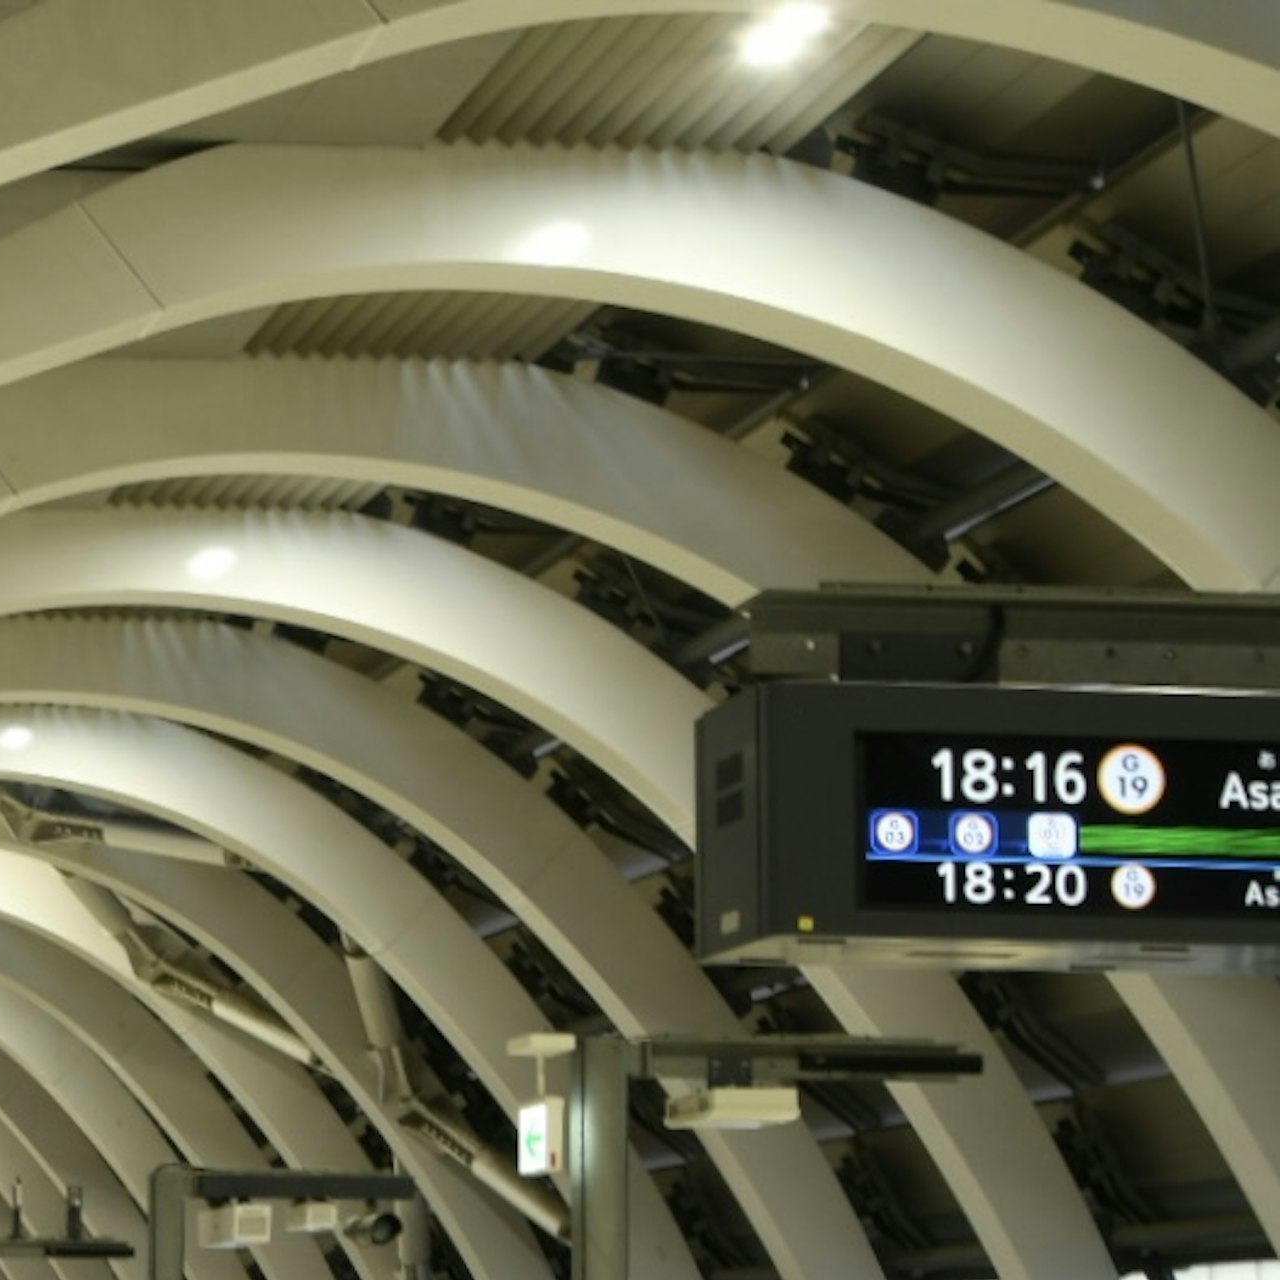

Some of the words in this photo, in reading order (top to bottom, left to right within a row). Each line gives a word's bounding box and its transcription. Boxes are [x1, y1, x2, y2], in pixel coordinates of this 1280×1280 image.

[1122, 754, 1140, 772] G
[931, 748, 1087, 804] 18:16
[1117, 776, 1149, 798] 19
[936, 861, 1087, 906] 18:20
[1122, 881, 1145, 899] 19
